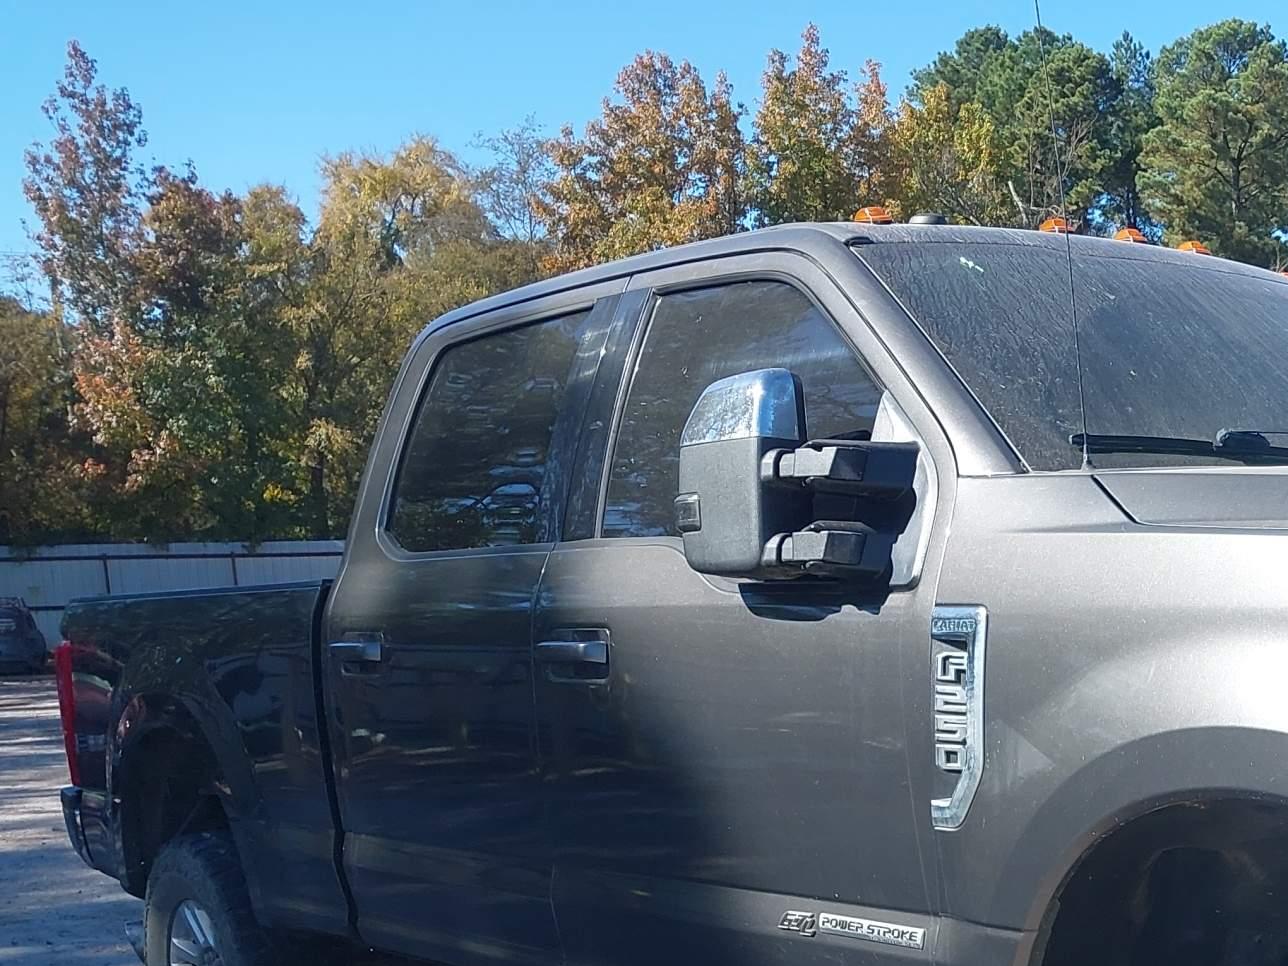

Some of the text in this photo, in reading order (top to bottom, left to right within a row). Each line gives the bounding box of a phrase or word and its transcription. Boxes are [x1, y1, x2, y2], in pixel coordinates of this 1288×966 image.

[934, 620, 974, 632] LARIAT
[822, 917, 864, 933] POWER
[867, 925, 919, 942] STROKE
